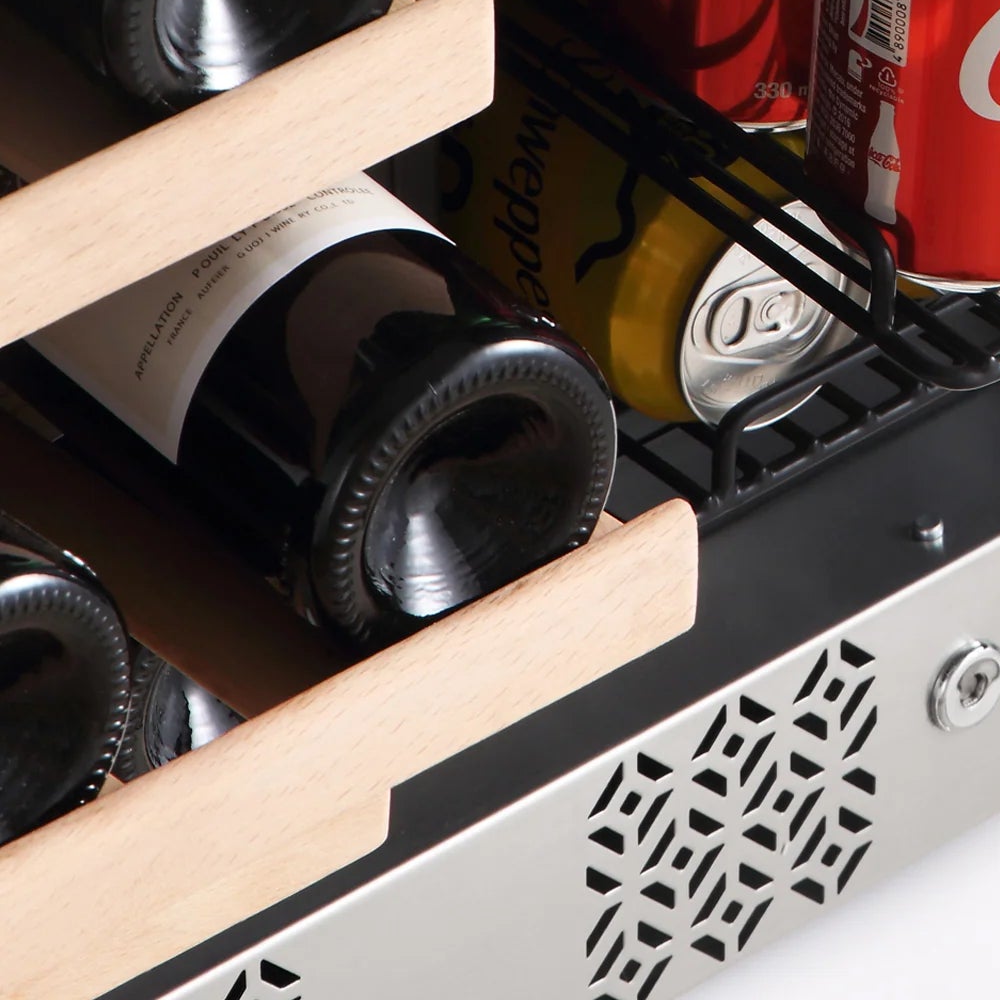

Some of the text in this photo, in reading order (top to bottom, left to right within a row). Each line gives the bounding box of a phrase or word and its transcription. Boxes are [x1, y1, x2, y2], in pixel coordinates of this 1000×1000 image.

[893, 3, 908, 51] 890008
[753, 81, 793, 99] 330
[135, 291, 184, 381] APPELLATION
[167, 308, 193, 346] FRANCE
